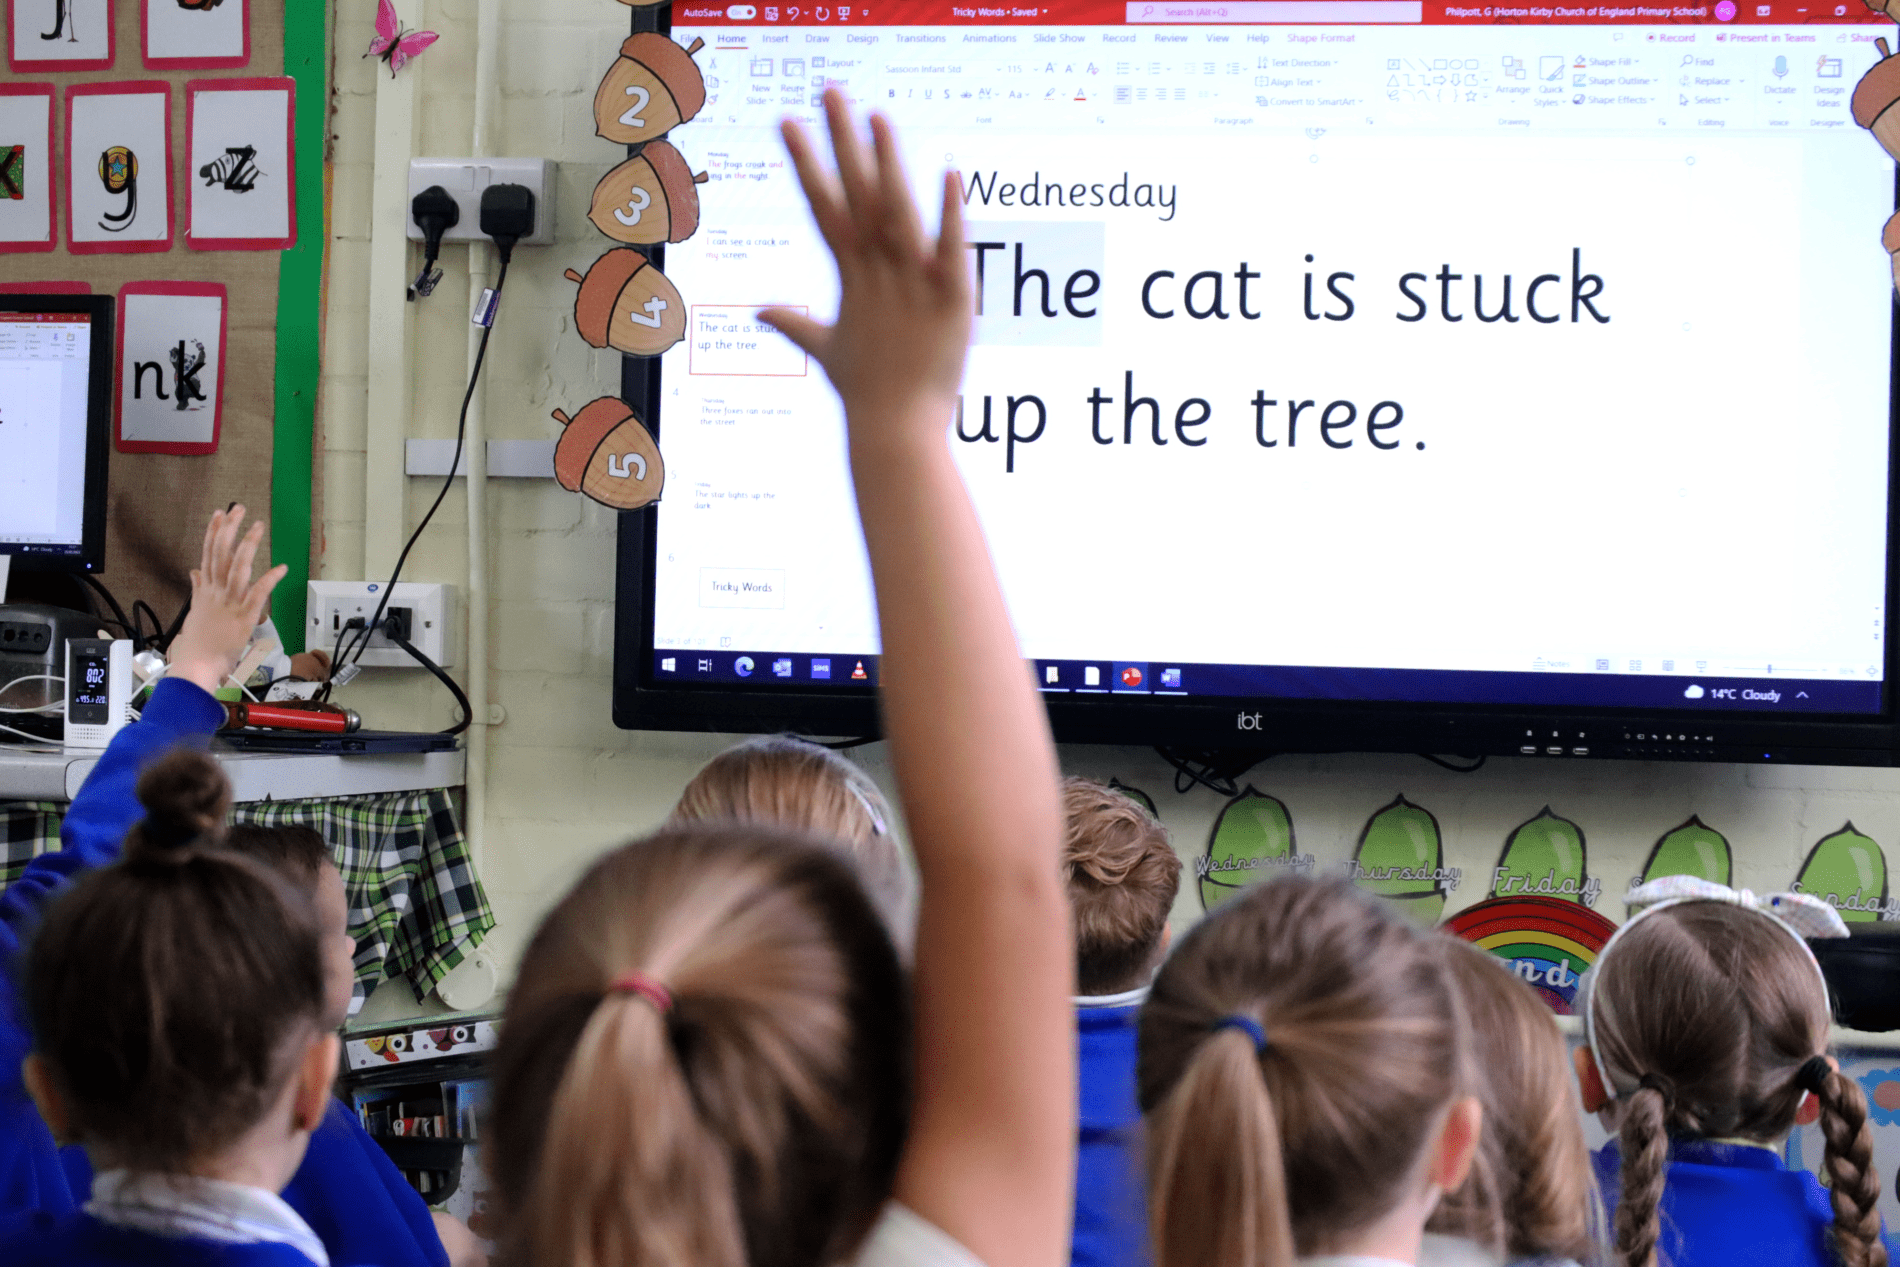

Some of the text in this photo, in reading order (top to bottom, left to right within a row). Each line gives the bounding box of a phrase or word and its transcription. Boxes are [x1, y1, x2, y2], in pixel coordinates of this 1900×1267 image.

[683, 8, 723, 18] AutoSave
[952, 7, 1038, 18] Tricky Words Saved
[1165, 7, 1194, 17] Search
[1530, 7, 1554, 18] Kirby
[1555, 7, 1586, 17] Church
[1587, 7, 1598, 17] of
[1599, 7, 1636, 18] England
[1637, 7, 1671, 18] Primary
[717, 34, 747, 43] Home
[762, 34, 789, 43] Insert
[805, 34, 830, 43] Draw
[846, 34, 879, 46] Design
[896, 34, 946, 43] Transitions
[962, 34, 1017, 43] Animations
[1033, 34, 1086, 43] Slide Show
[1103, 34, 1136, 43] Record
[1154, 34, 1188, 43] Review
[1206, 34, 1229, 43] View
[1247, 34, 1270, 44] Help
[1287, 34, 1355, 45] Shape Format
[1660, 33, 1696, 43] Record
[1730, 33, 1816, 43] Present in Teams
[1851, 33, 1876, 43] Shar
[826, 59, 855, 69] Layout
[1272, 58, 1331, 67] Text Direction
[1589, 57, 1631, 68] Shape Fill
[1695, 58, 1714, 67] Find
[885, 65, 919, 74] Sassoon
[921, 65, 945, 74] Infant
[826, 77, 849, 87] Reset
[1270, 77, 1313, 88] Align Text
[1588, 76, 1650, 87] Shape Outline
[1695, 76, 1731, 87] Replace
[752, 84, 770, 93] New
[1496, 85, 1531, 95] Arrange
[1538, 85, 1564, 95] Quick
[1764, 85, 1796, 94] Dictate
[1813, 85, 1845, 95] Design
[746, 96, 767, 105] Slide
[780, 96, 805, 105] Slides
[1588, 96, 1616, 106] Shape
[1695, 96, 1721, 105] Select
[1816, 99, 1841, 108] Ideas
[619, 85, 651, 128] 2
[708, 160, 783, 170] The frogs croak and
[709, 172, 723, 181] ing
[957, 170, 1177, 222] Wednesday
[613, 186, 651, 226] 3
[754, 237, 776, 246] crack
[964, 240, 1612, 324] The cat is stuck
[630, 296, 668, 329] 4
[699, 321, 719, 333] The
[722, 324, 738, 333] cat
[742, 324, 751, 333] is
[698, 341, 711, 353] up
[715, 339, 730, 350] the
[134, 339, 207, 402] nk
[954, 369, 1427, 474] up the tree.
[607, 451, 648, 481] 5
[695, 489, 709, 499] The
[712, 580, 773, 595] Tricky Words
[86, 668, 105, 684] 802
[1742, 688, 1781, 703] Cloudy
[1237, 711, 1263, 730] ibt
[1194, 851, 1316, 877] Wednesday
[1344, 859, 1463, 891] Thursday
[1491, 866, 1602, 908] Friday
